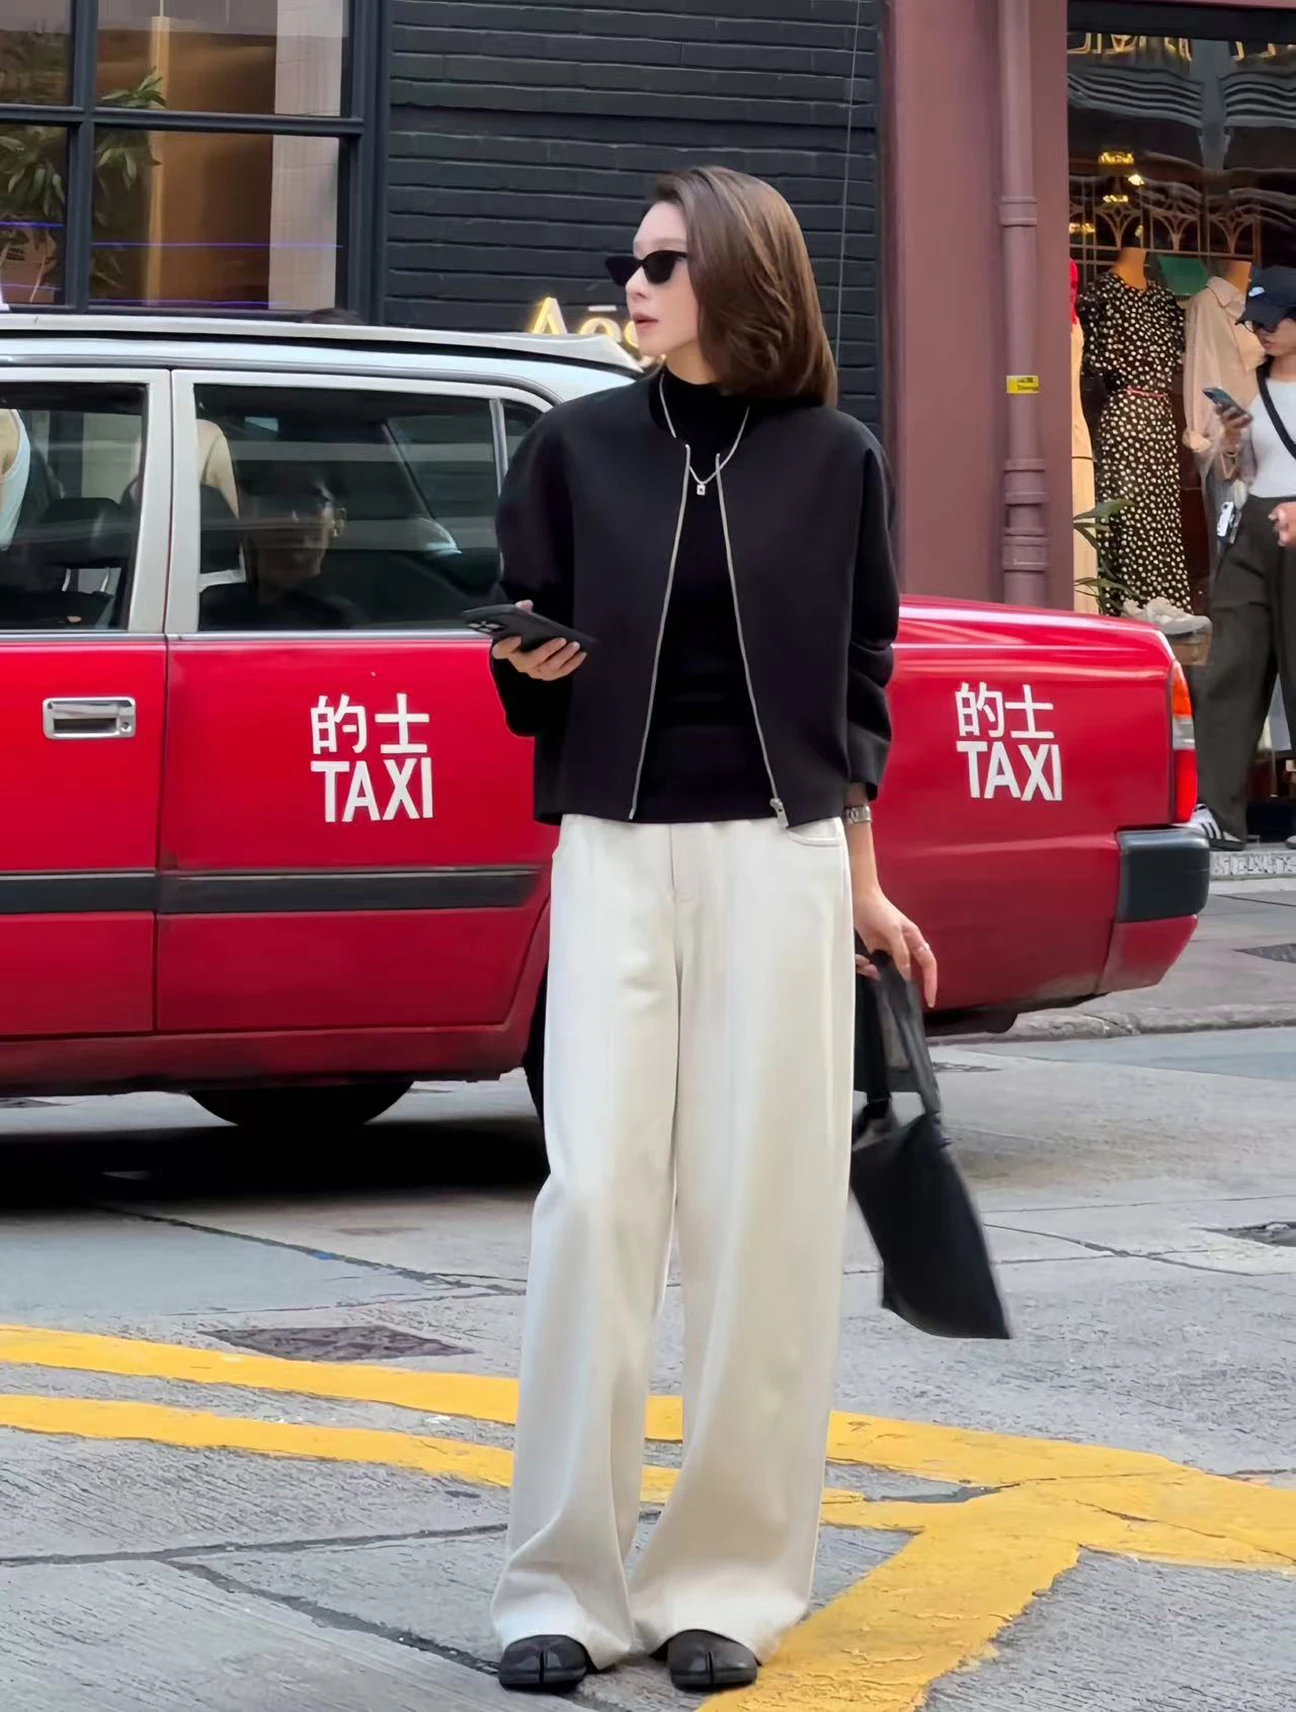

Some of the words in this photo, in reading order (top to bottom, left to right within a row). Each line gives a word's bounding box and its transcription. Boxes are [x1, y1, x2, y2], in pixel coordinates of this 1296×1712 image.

[310, 693, 430, 754] 的士
[955, 682, 1054, 738] 的士
[310, 757, 433, 822] TAXI
[956, 741, 1062, 801] TAXI
